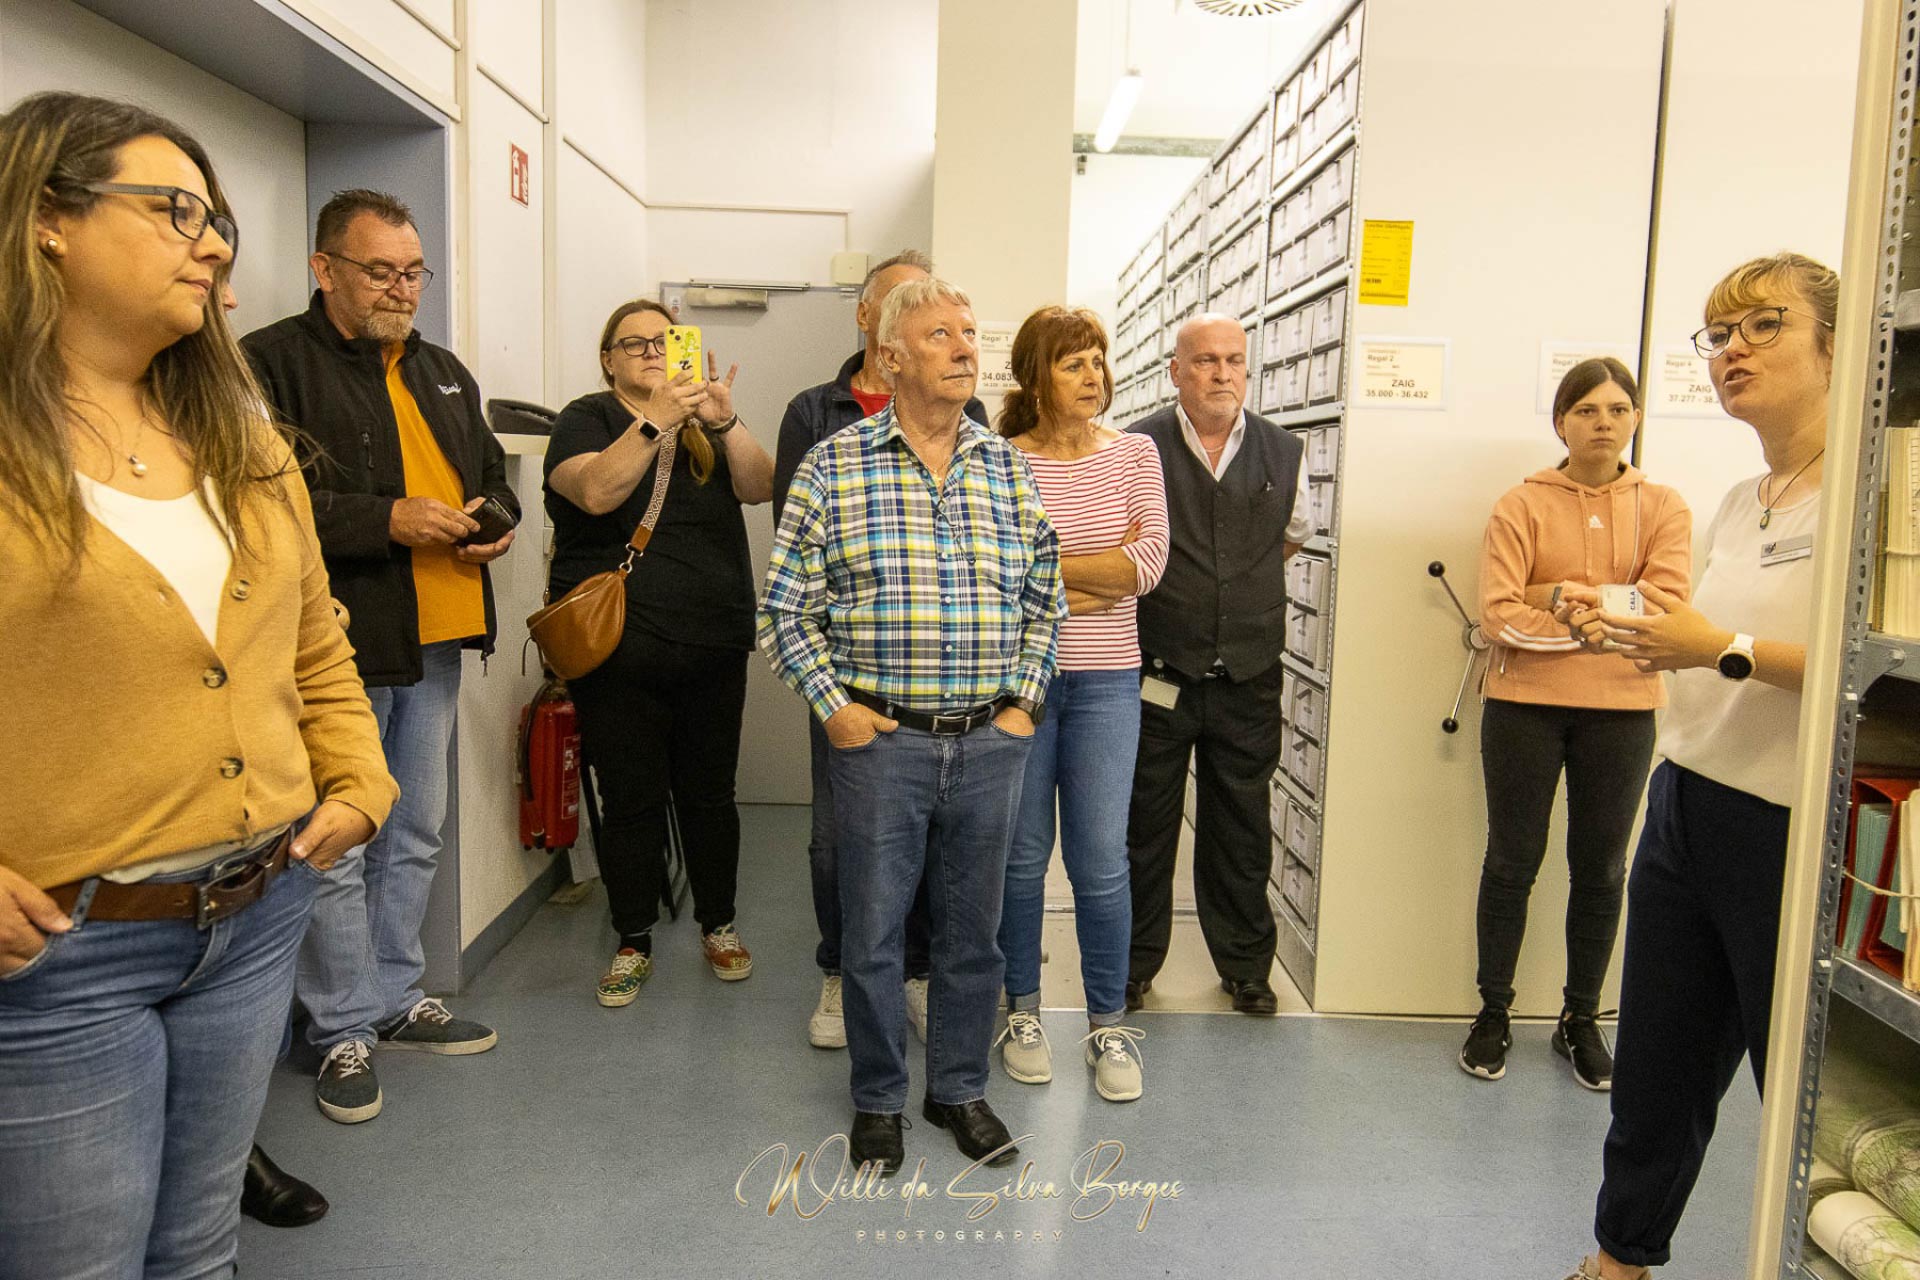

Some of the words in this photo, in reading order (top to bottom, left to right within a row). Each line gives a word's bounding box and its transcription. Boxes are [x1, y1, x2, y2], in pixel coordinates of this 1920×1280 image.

[981, 334, 1001, 343] Regal
[1367, 354, 1388, 363] Regal
[1666, 359, 1686, 368] Regal
[1391, 379, 1416, 388] ZAIG
[1688, 384, 1712, 393] ZAIG
